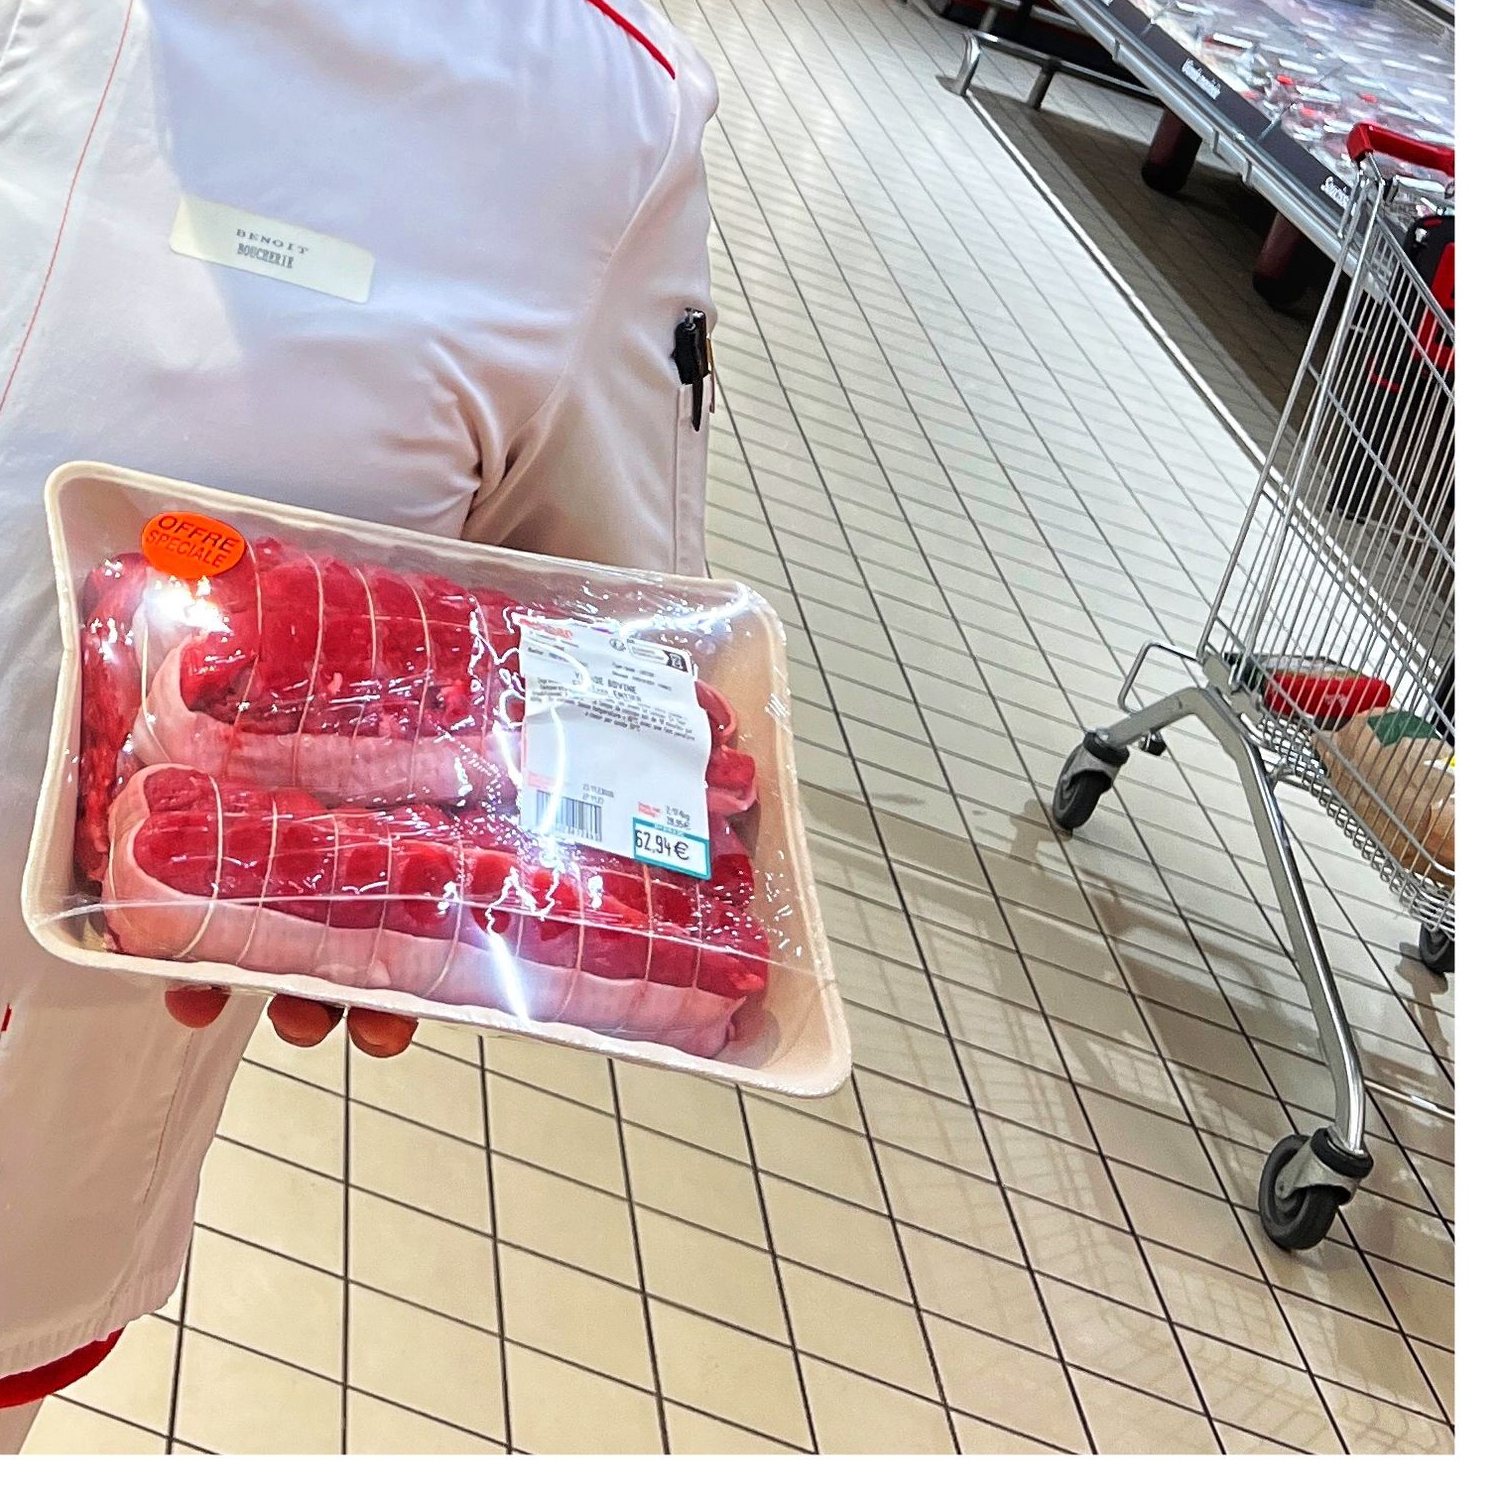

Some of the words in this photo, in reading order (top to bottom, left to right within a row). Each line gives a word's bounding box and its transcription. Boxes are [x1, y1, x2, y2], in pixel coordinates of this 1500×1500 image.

[235, 228, 309, 255] BENOIT
[236, 242, 294, 269] BOUCHERIE
[146, 529, 227, 569] SPECIALE
[157, 515, 241, 554] OFFRE
